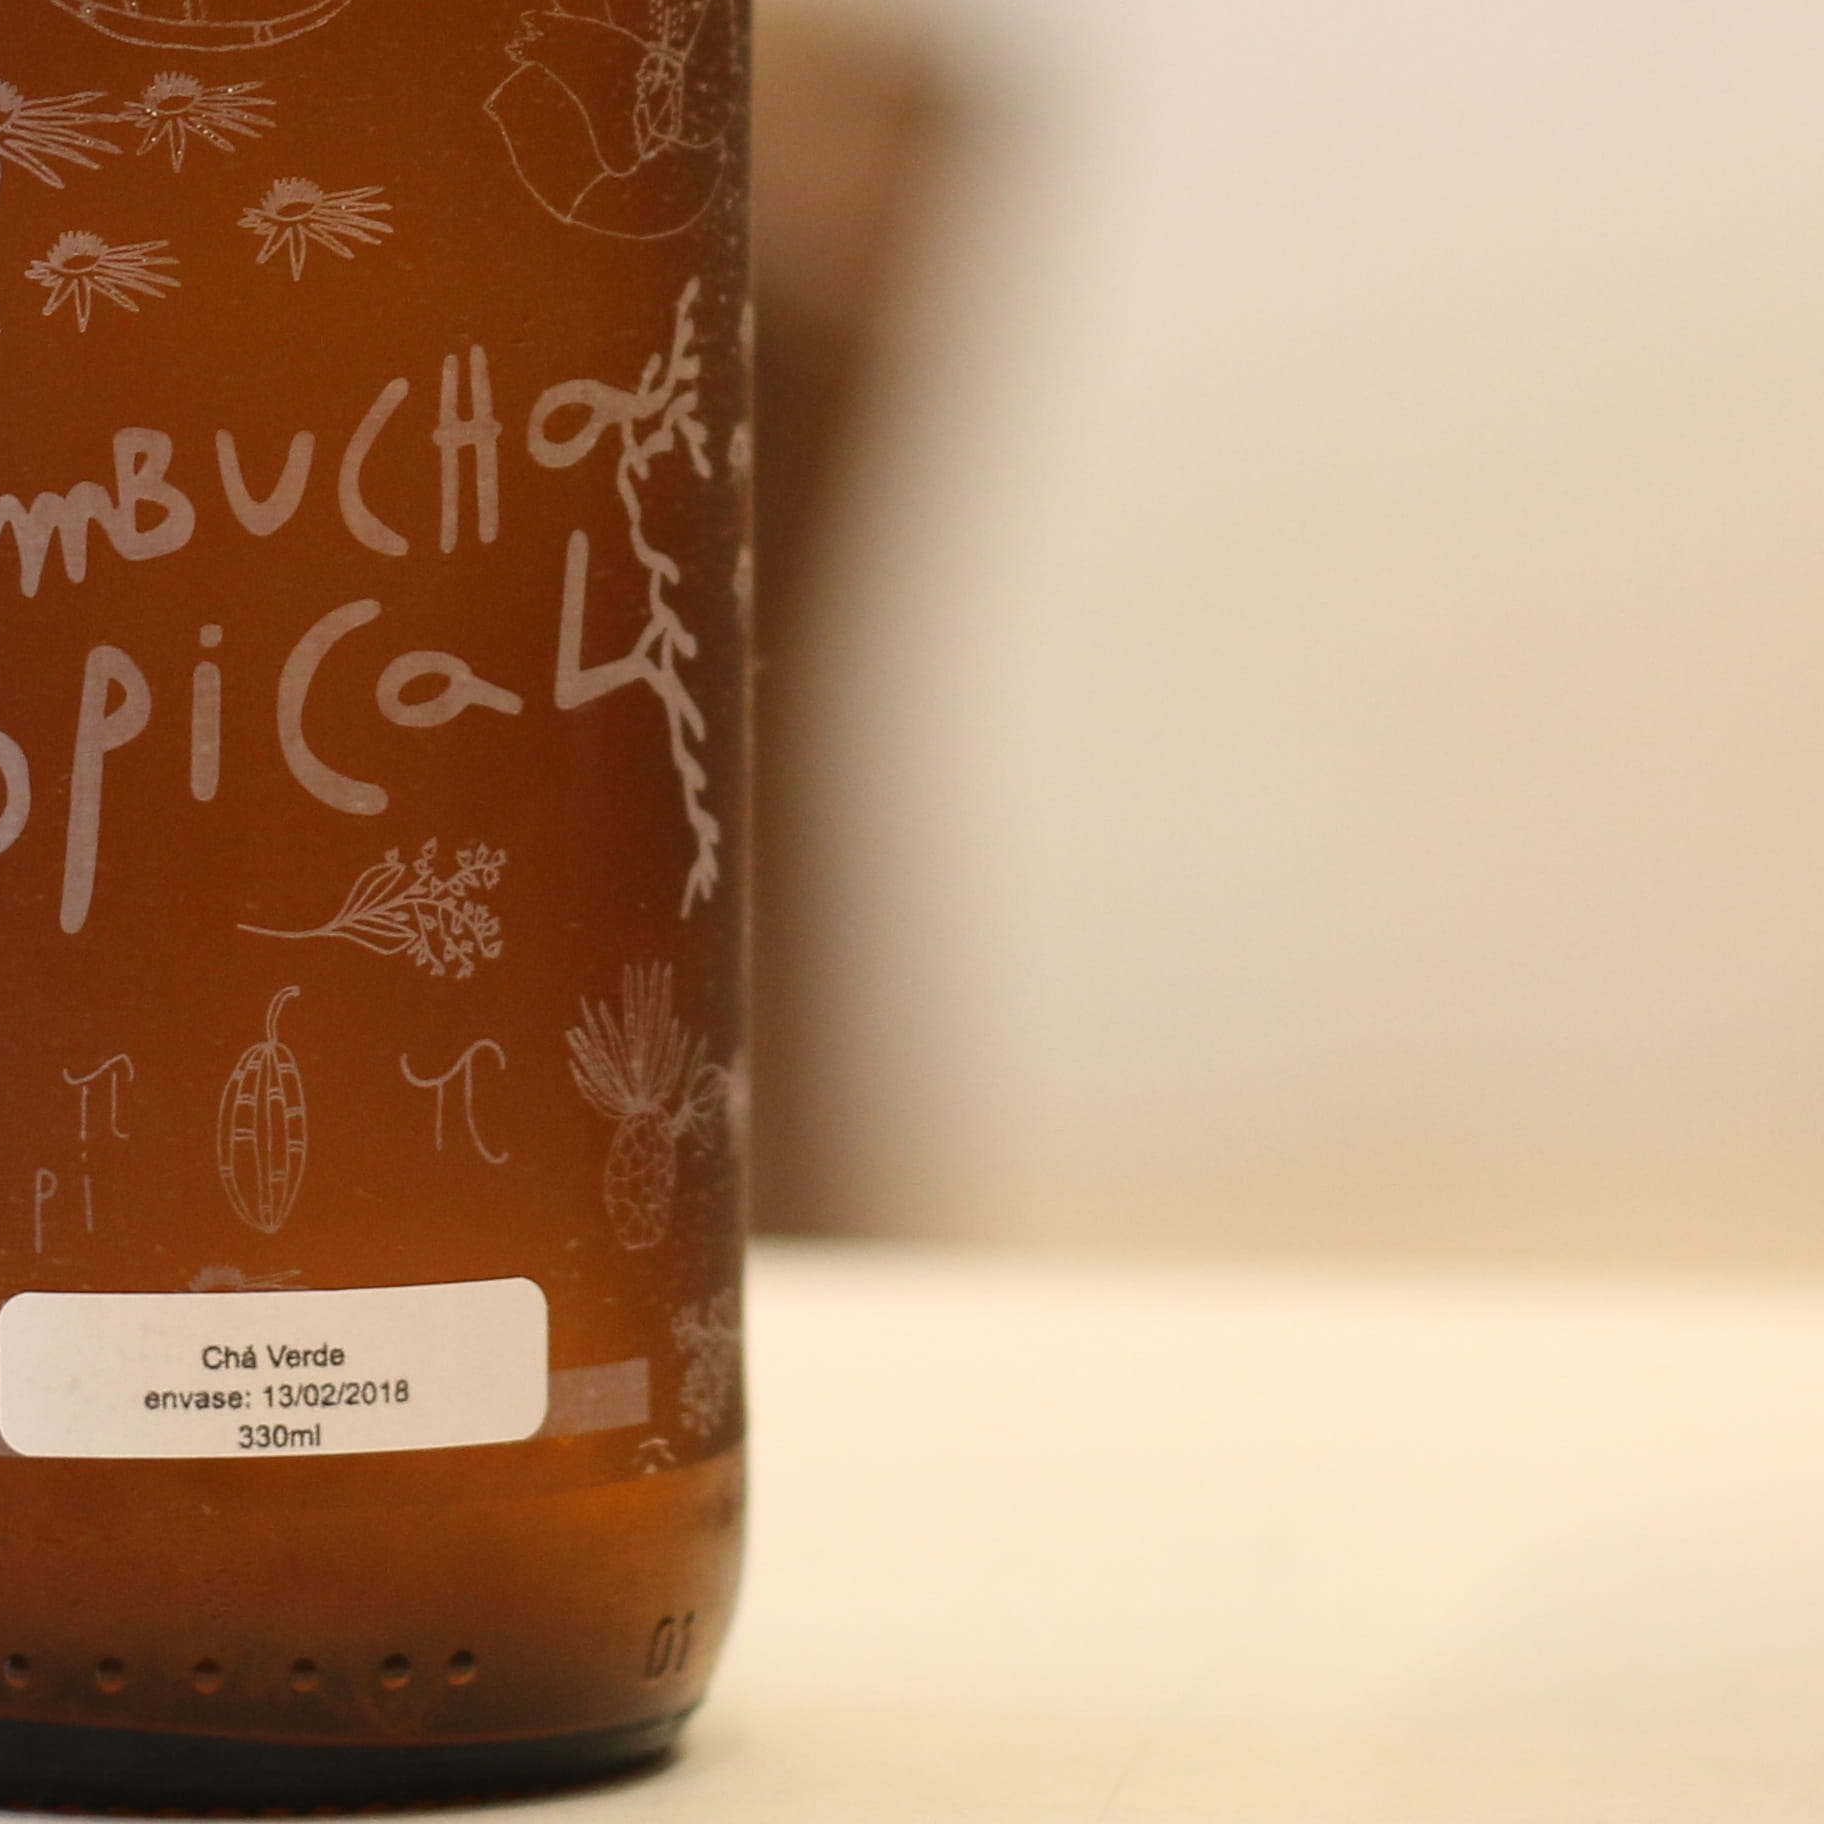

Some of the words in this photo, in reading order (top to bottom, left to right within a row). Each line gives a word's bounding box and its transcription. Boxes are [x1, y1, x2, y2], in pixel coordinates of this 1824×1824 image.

[200, 1343, 259, 1372] Chá
[266, 1340, 347, 1370] Verde
[143, 1390, 253, 1413] envase:
[261, 1378, 412, 1411] 13/02/2018
[237, 1422, 323, 1451] 330ml
